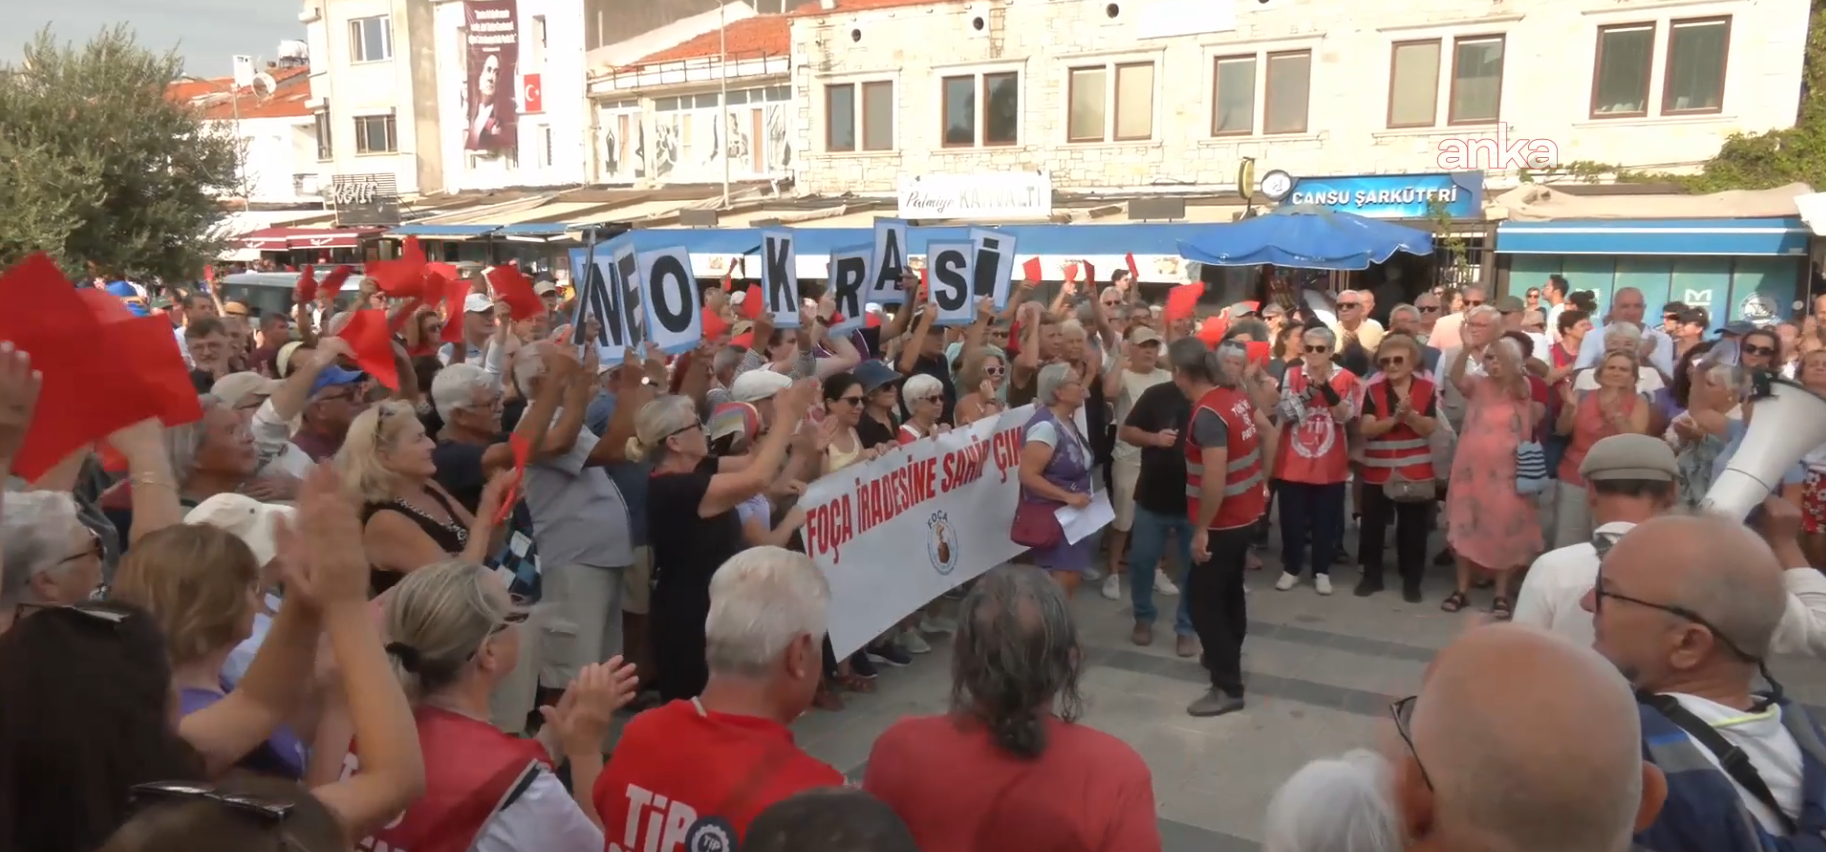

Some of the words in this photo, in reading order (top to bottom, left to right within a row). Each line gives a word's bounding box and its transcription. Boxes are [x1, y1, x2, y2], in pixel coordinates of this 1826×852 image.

[1292, 191, 1349, 206] CANSU
[1355, 185, 1458, 208] ŞARKÜTERİ
[805, 494, 853, 565] FOÇA
[855, 454, 937, 535] İRADESİNE
[941, 434, 991, 493] SAHİP
[927, 509, 949, 530] FOÇA
